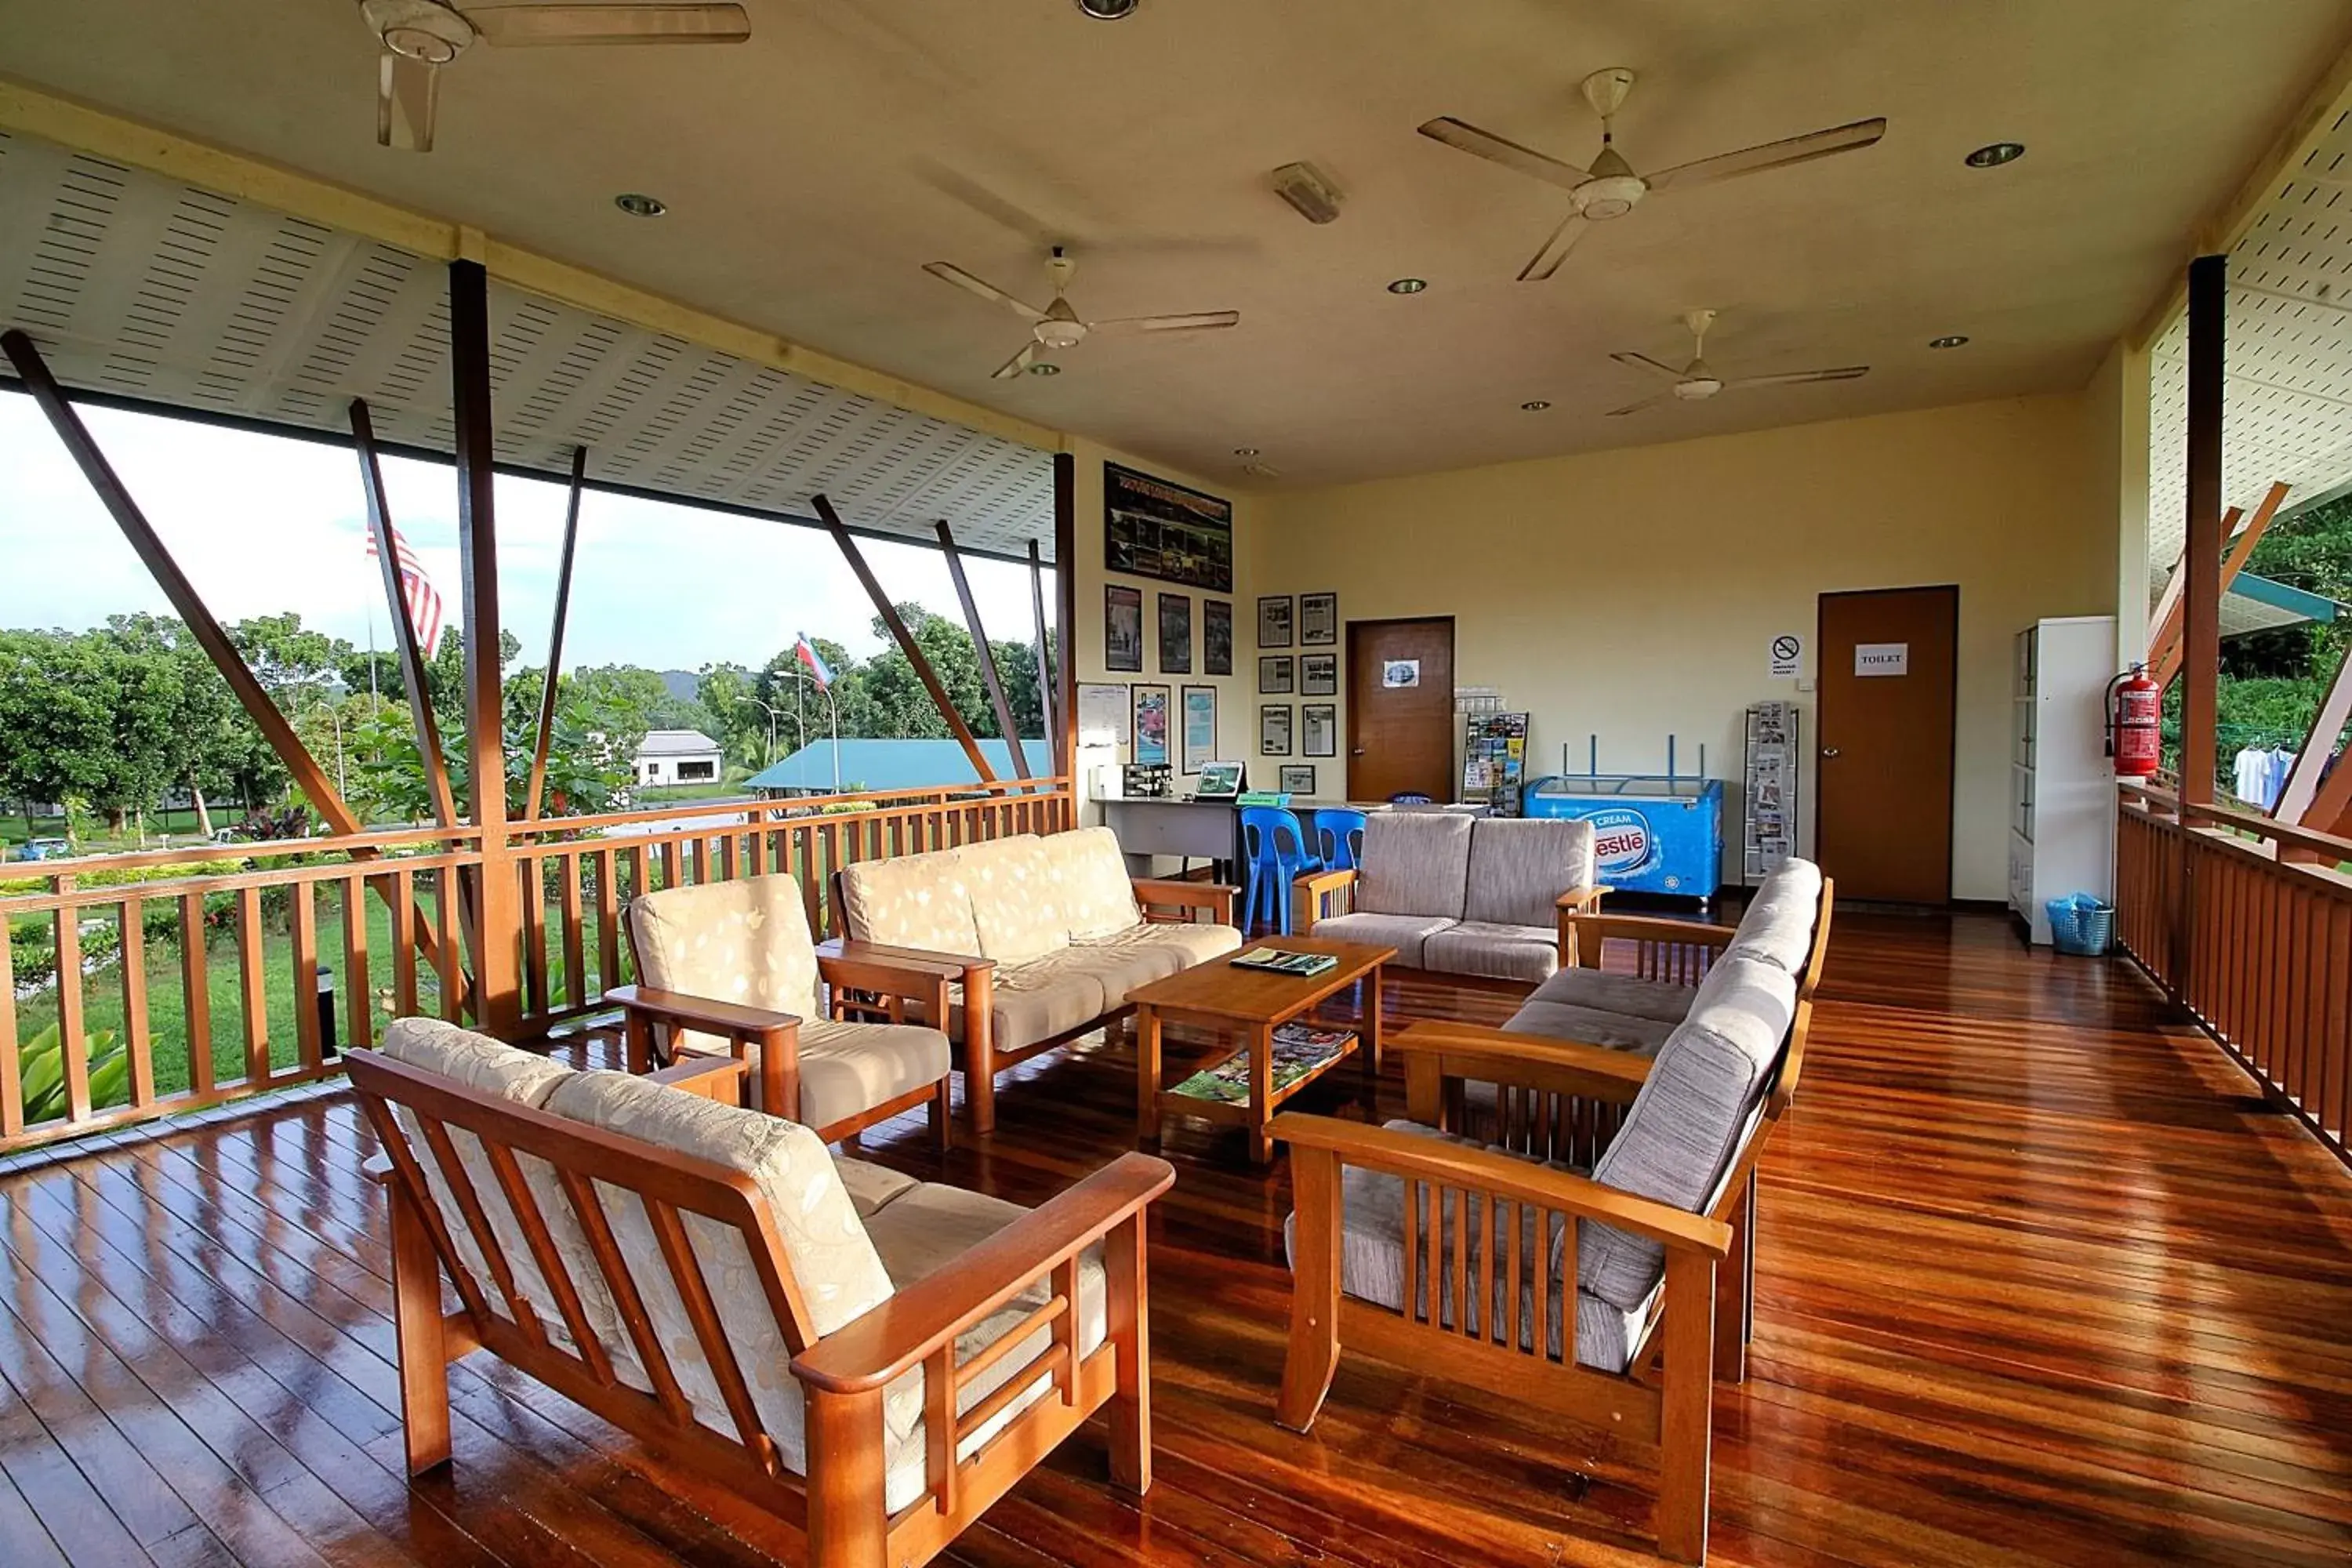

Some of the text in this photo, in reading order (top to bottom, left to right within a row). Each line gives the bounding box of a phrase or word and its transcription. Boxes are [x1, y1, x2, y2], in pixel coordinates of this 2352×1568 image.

[1861, 654, 1901, 664] TOILET
[1596, 815, 1632, 826] CREAM
[1595, 832, 1644, 857] estlé
